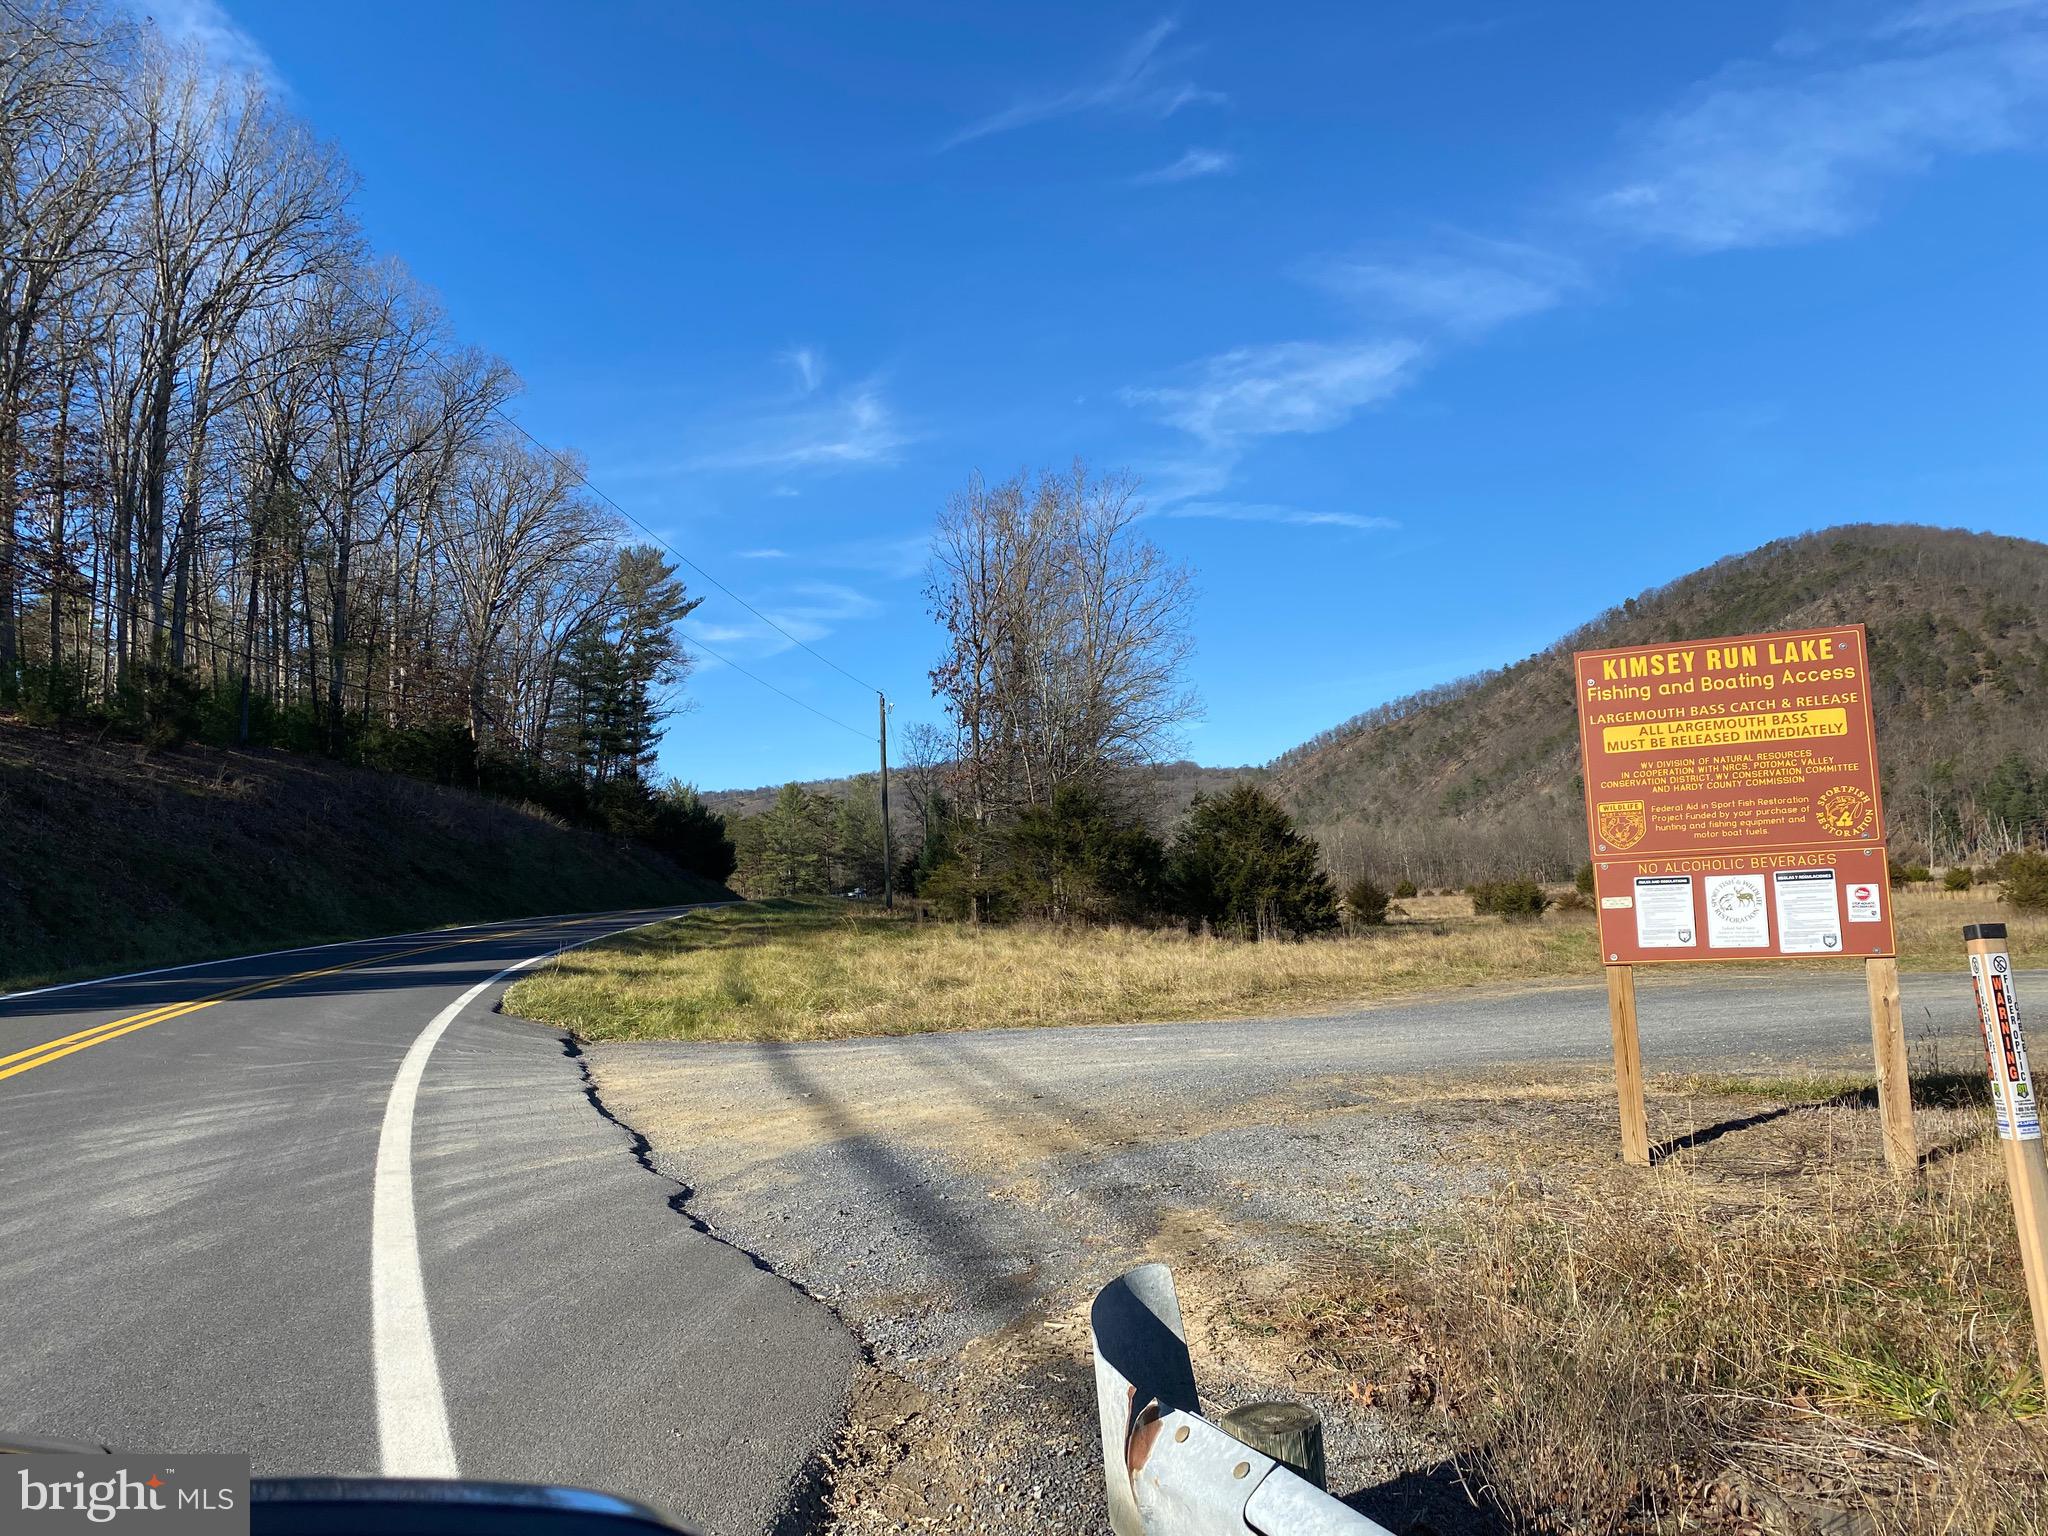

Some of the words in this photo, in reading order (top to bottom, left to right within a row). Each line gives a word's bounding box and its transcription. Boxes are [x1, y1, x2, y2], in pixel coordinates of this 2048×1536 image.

[1603, 652, 1695, 680] KIMSEY
[1707, 647, 1757, 670] RUN
[1770, 638, 1833, 664] LAKE
[1587, 685, 1650, 702] Fishing
[1659, 679, 1695, 695] and
[1702, 673, 1774, 692] Boating
[1782, 666, 1855, 684] Access
[1590, 701, 1685, 725] LARGEMOUTH
[1690, 702, 1725, 717] BASS
[1731, 700, 1775, 713] CATCH
[1781, 699, 1792, 709] &
[1797, 693, 1858, 707] RELEASE
[1639, 725, 1664, 736] ALL
[1669, 716, 1766, 734] LARGEMOUTH
[1772, 713, 1808, 724] BASS
[1607, 739, 1645, 751] MUST
[1651, 736, 1667, 748] BE
[1671, 731, 1740, 747] RELEASED
[1746, 723, 1843, 741] IMMEDIATELY
[1634, 767, 1694, 778] COOPERATION
[1698, 765, 1719, 773] WITH
[1754, 759, 1797, 769] POTOMAC
[1801, 756, 1834, 765] VALLEY
[1657, 759, 1695, 768] DIVISION
[1714, 754, 1753, 763] NATURAL
[1757, 750, 1812, 760] RESOURCES
[1601, 778, 1666, 788] CONSERVATION
[1732, 768, 1801, 779] CONSERVATION
[1806, 763, 1859, 774] COMMITTEE
[1653, 785, 1670, 793] AND
[1674, 783, 1703, 791] HARDY
[1707, 780, 1742, 789] COUNTY
[1746, 776, 1805, 786] COMMISSION
[1603, 803, 1639, 811] WILDLIFE
[1652, 804, 1683, 812] Federal
[1711, 801, 1735, 811] Sport
[1738, 799, 1755, 807] Fish
[1758, 796, 1809, 806] Restoration
[1817, 786, 1871, 806] SPORTFISH
[1652, 814, 1683, 823] Project
[1686, 811, 1717, 820] Funded
[1719, 811, 1730, 819] by
[1733, 809, 1753, 819] your
[1756, 806, 1797, 817] purchase
[1801, 805, 1810, 813] of
[1656, 824, 1686, 832] hunting
[1709, 819, 1737, 829] fishing
[1740, 816, 1785, 827] equipment
[1789, 815, 1805, 823] and
[1816, 809, 1873, 837] RESTORATION
[1639, 863, 1658, 874] NO
[1665, 858, 1745, 872] ALCOHOLIC
[1751, 854, 1837, 869] BEVERAGES
[1992, 978, 2018, 1080] WARNING
[2003, 975, 2016, 1025] FIBER
[2013, 1031, 2026, 1081] OPTIC
[2015, 1002, 2026, 1053] CABLE
